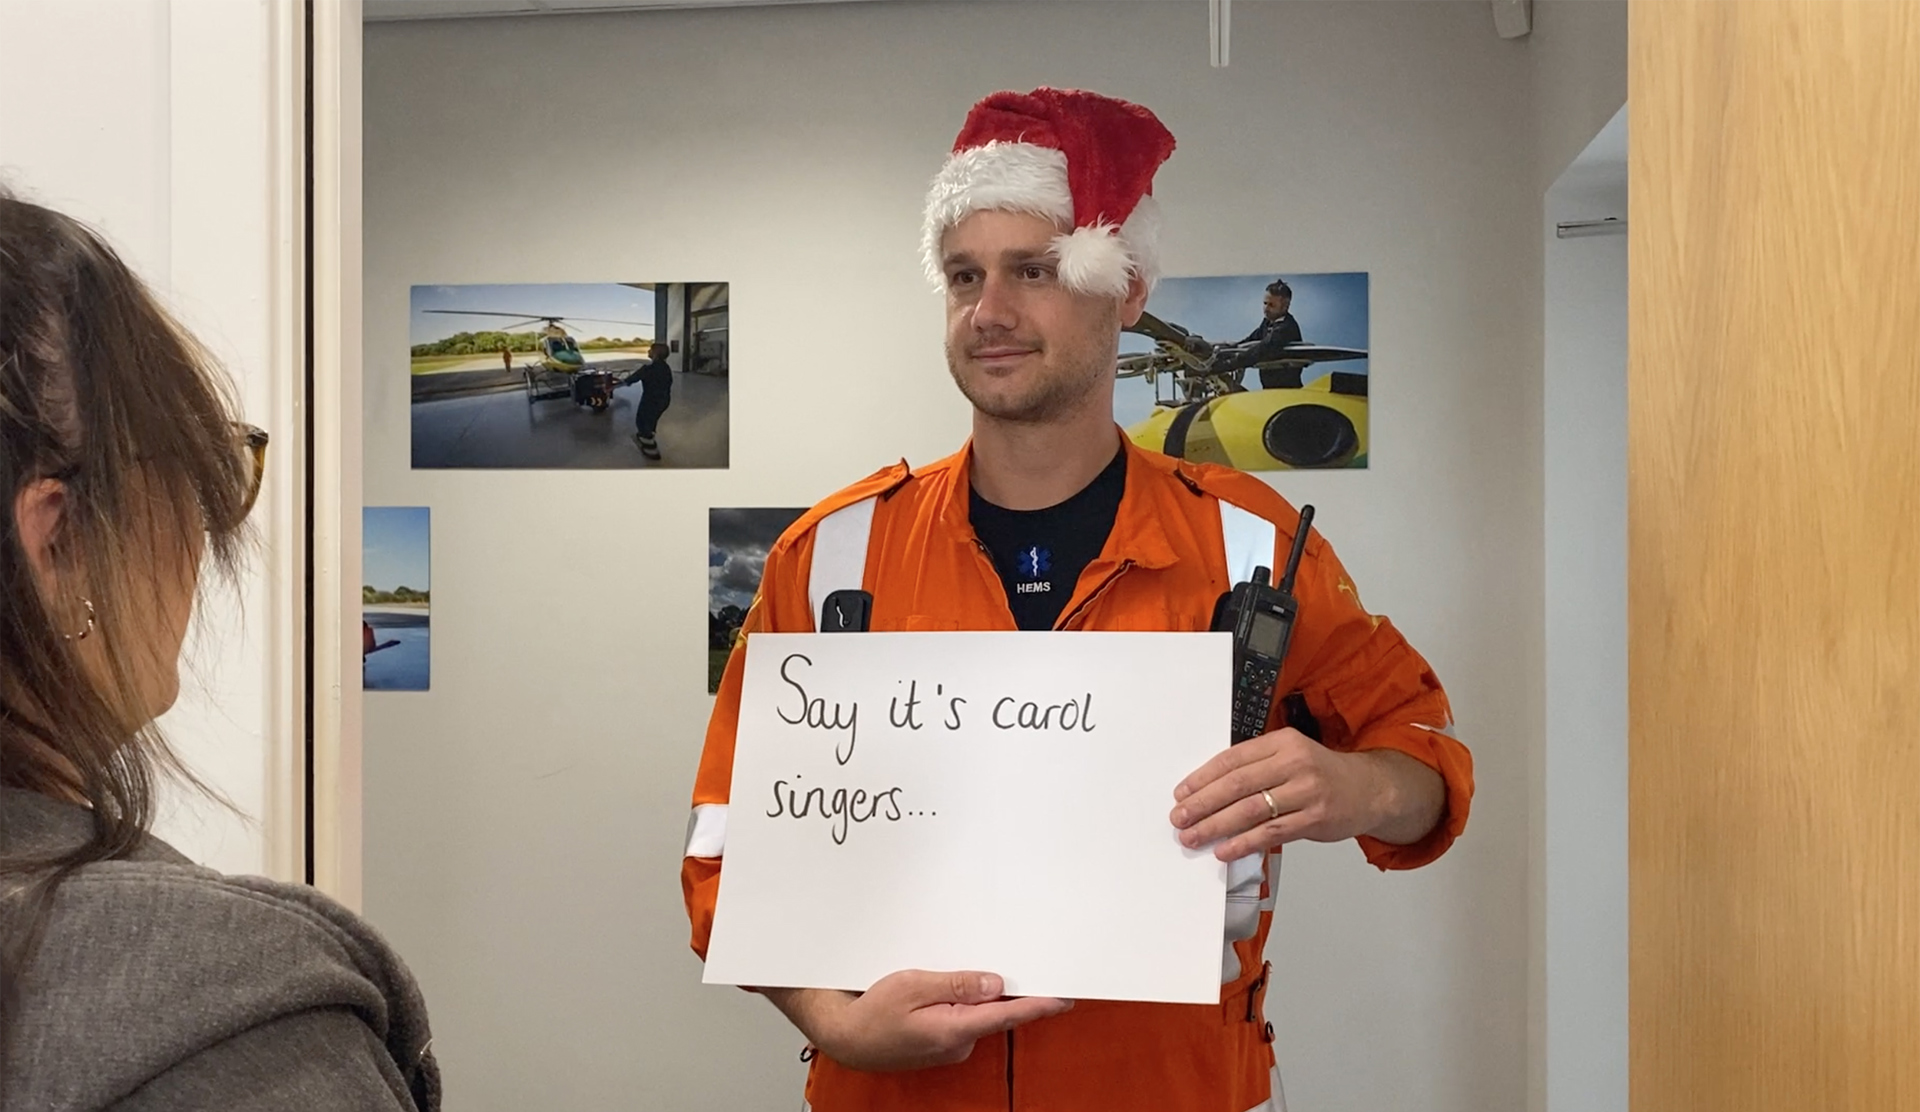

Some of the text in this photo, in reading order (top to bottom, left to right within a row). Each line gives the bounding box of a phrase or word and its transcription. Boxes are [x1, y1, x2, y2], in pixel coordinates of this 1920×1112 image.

[1016, 581, 1051, 594] HEMS
[777, 653, 1096, 766] Say it's carol
[766, 774, 937, 846] singers...
